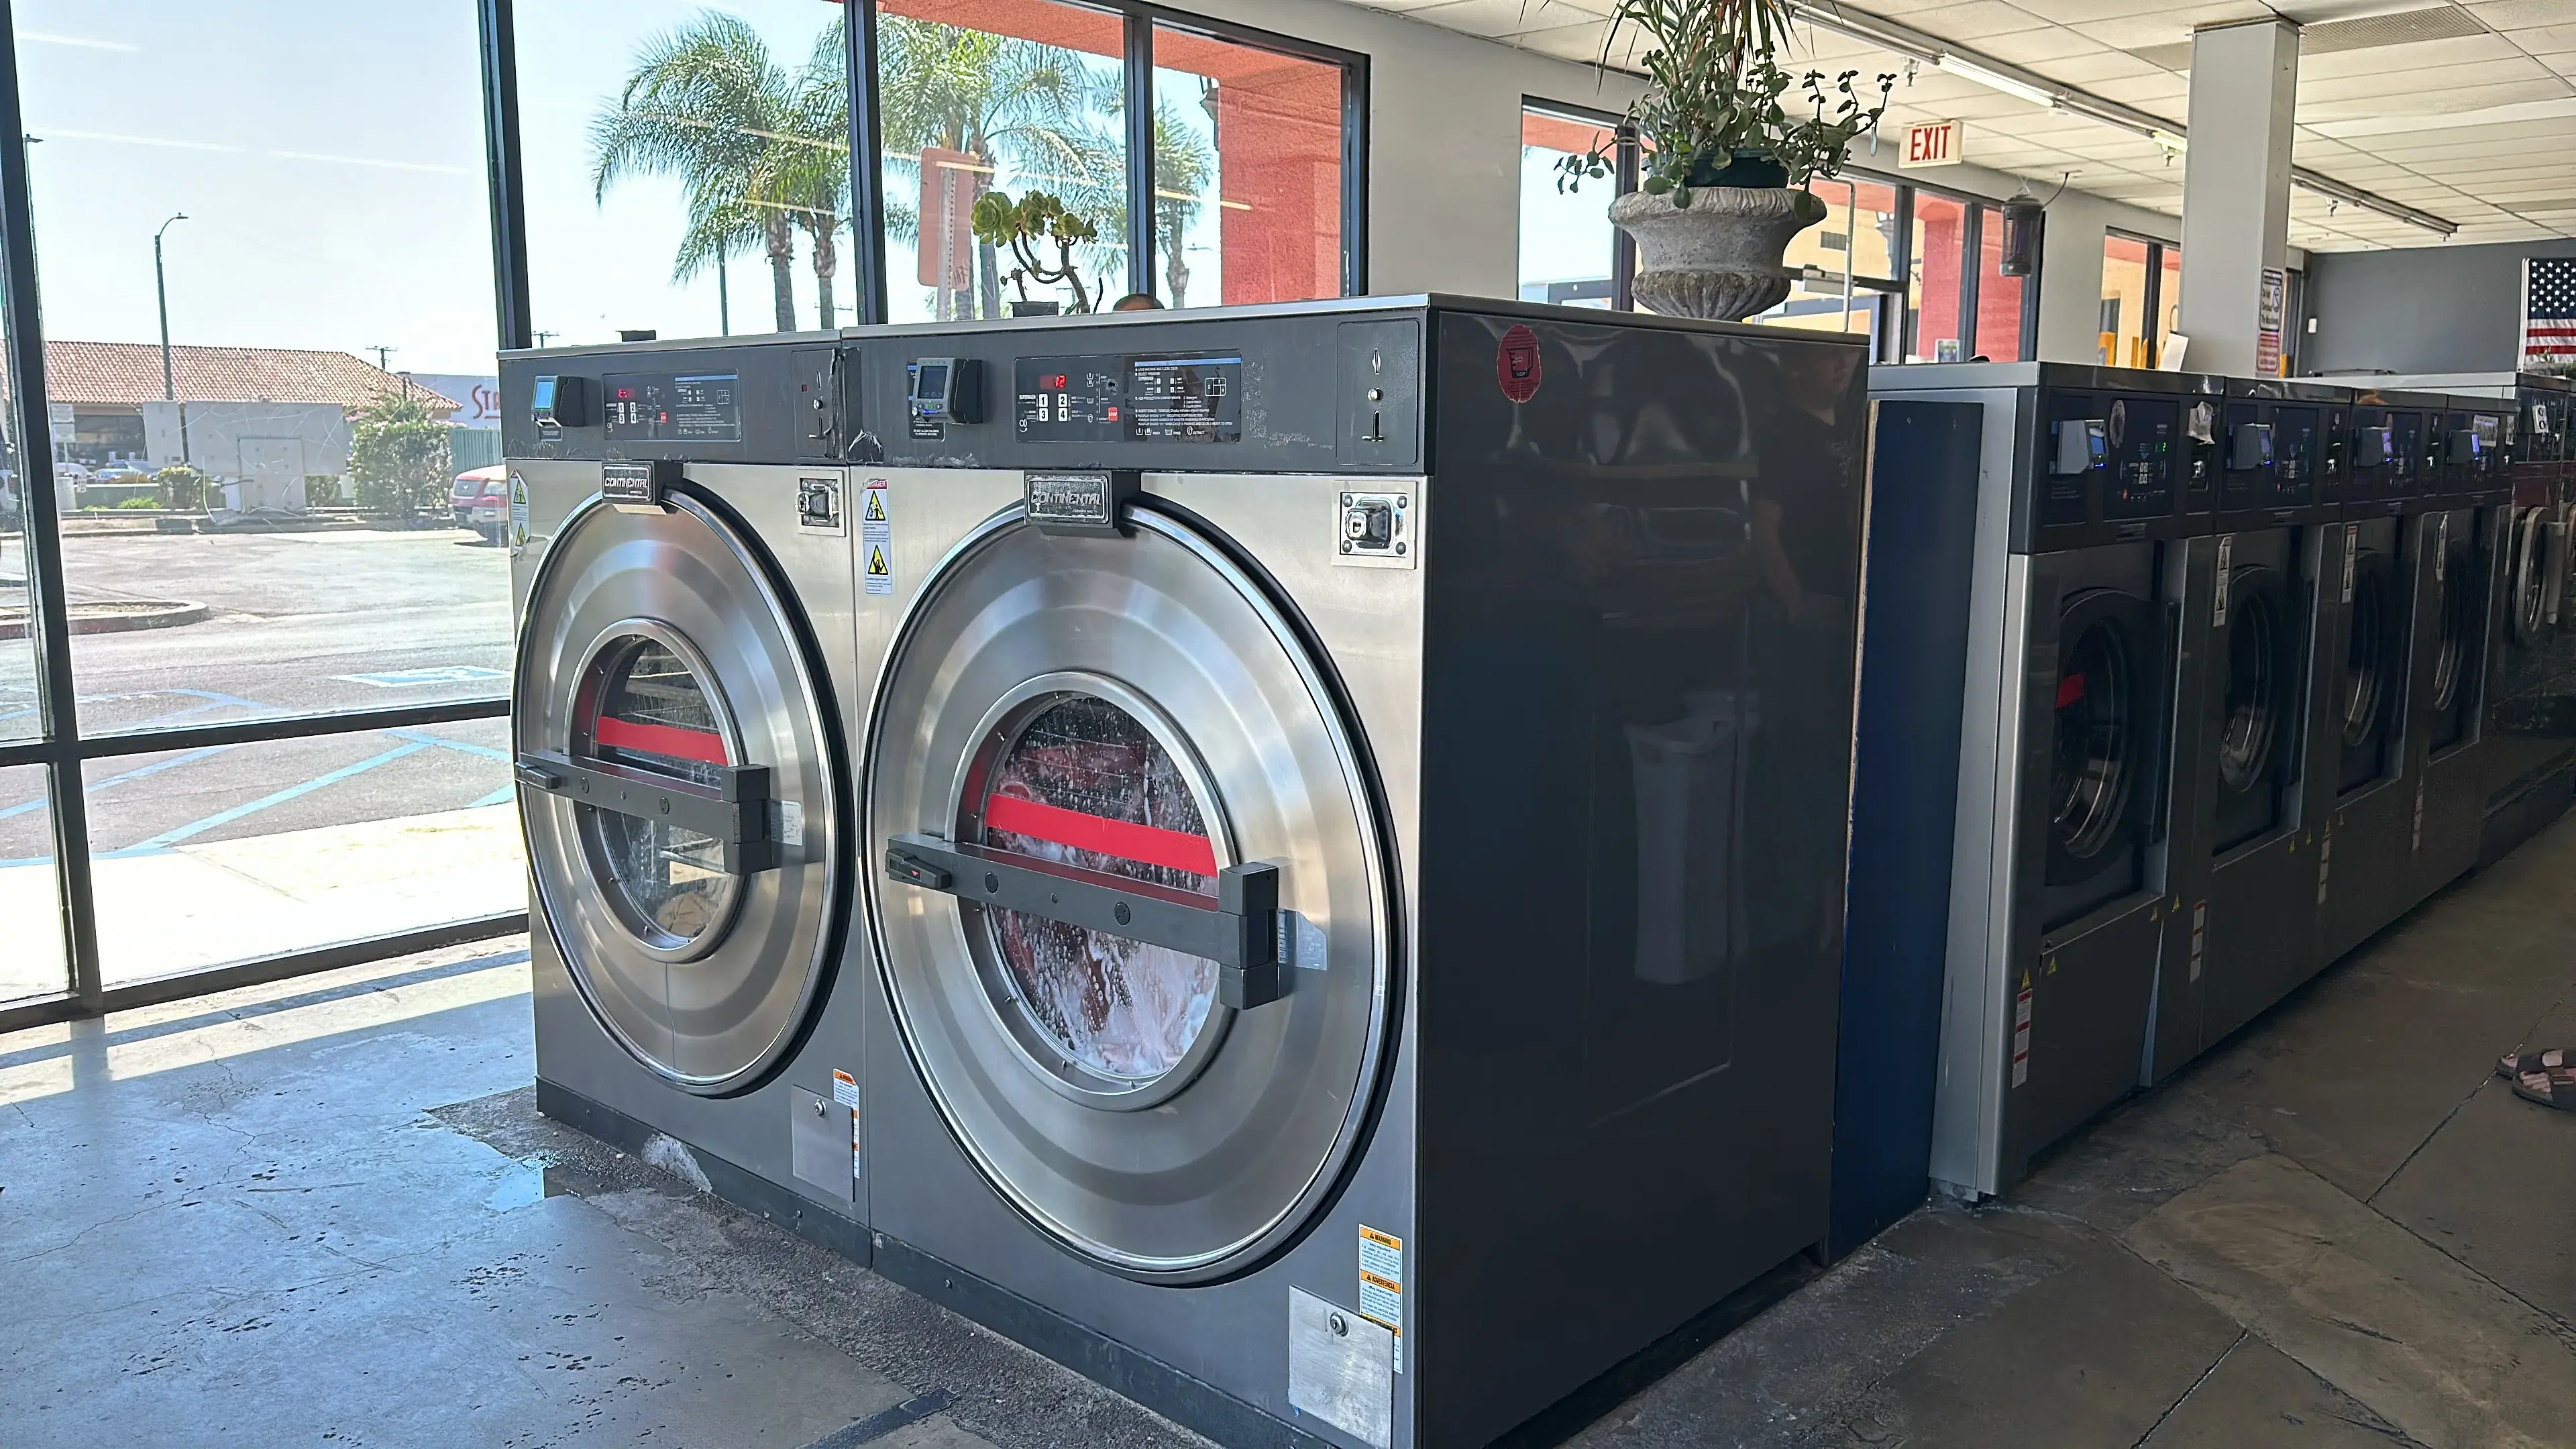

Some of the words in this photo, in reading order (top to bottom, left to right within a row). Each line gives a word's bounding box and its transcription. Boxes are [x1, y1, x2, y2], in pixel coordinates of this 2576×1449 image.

[1910, 125, 1951, 161] EXIT
[604, 477, 648, 488] CONTINENTAL
[1031, 490, 1102, 505] CONTINENTAL
